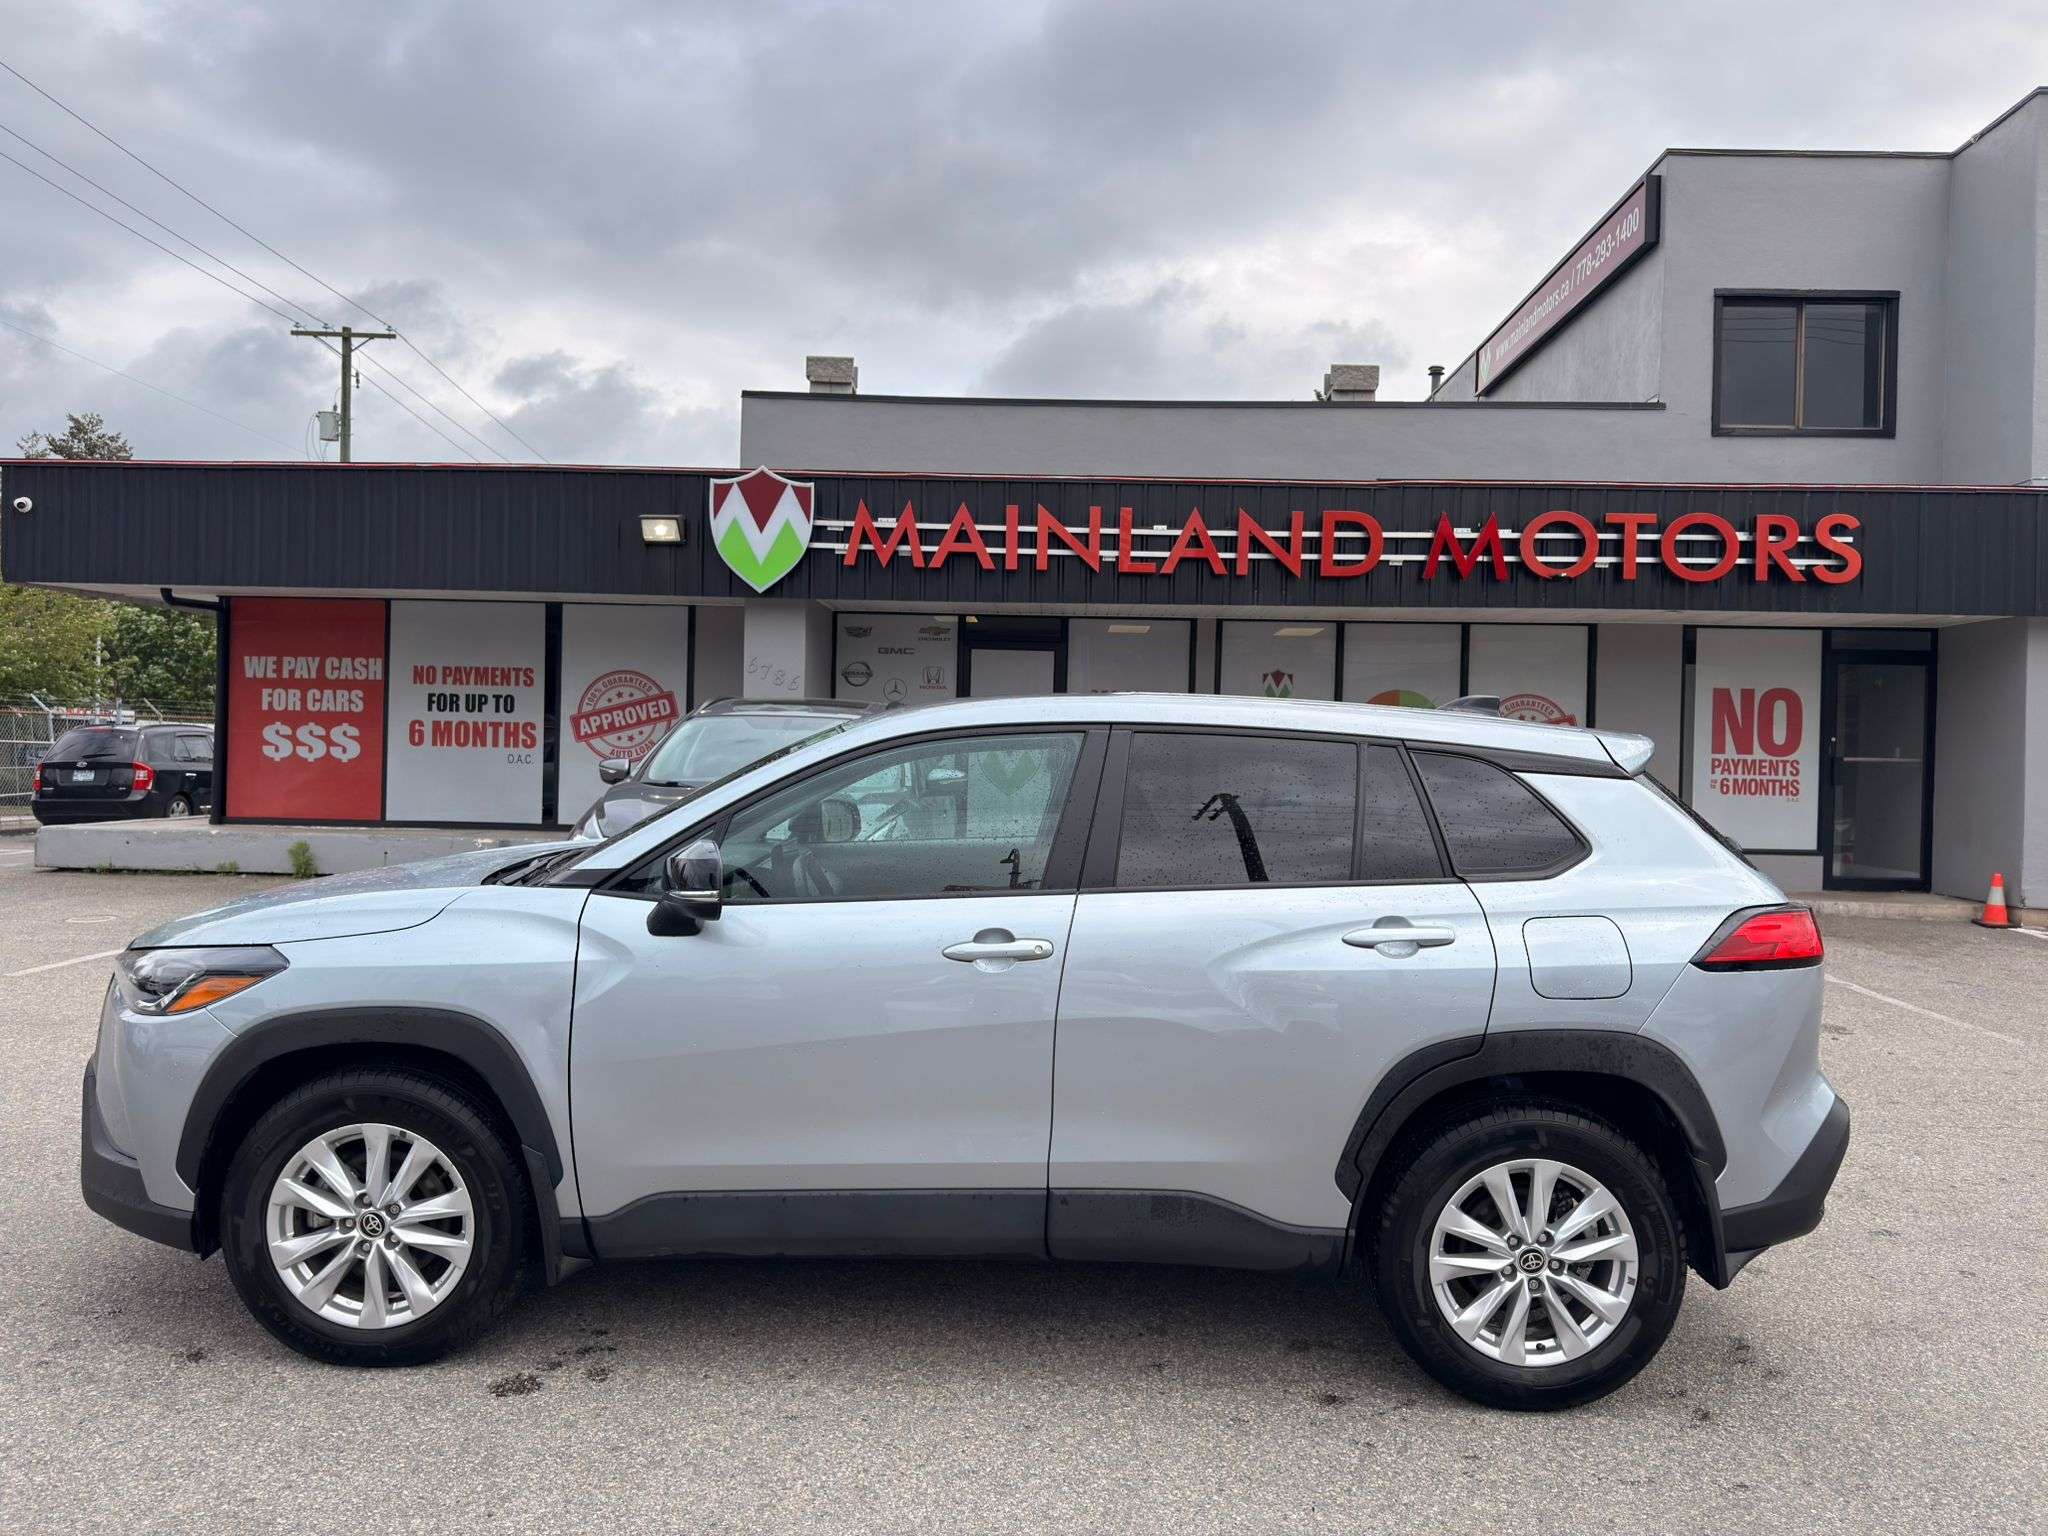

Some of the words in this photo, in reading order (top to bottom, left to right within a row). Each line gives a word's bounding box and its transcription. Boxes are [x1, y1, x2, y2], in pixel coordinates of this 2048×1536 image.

[1577, 207, 1639, 285] 778-293-1400
[843, 498, 1384, 579] MAINLAND
[1423, 511, 1863, 585] MOTORS
[878, 647, 915, 655] GMC
[244, 656, 277, 678] WE
[282, 657, 320, 679] PAY
[325, 657, 382, 680] CASH
[413, 665, 437, 685] NO
[442, 666, 535, 688] PAYMENTS
[602, 676, 654, 693] GUARANTEED
[262, 688, 300, 711] FOR
[306, 689, 364, 712] CARS
[427, 693, 460, 712] FOR
[465, 694, 488, 713] UP
[492, 694, 515, 713] TO
[580, 699, 671, 736] APPROVED
[1711, 687, 1803, 757] NO
[262, 722, 361, 762] $$$
[409, 719, 425, 746] 6
[432, 720, 537, 749] MONTHS
[609, 747, 633, 758] AUTO
[1711, 758, 1800, 777] PAYMENTS
[1720, 778, 1730, 795] 6
[1733, 778, 1800, 797] MONTHS
